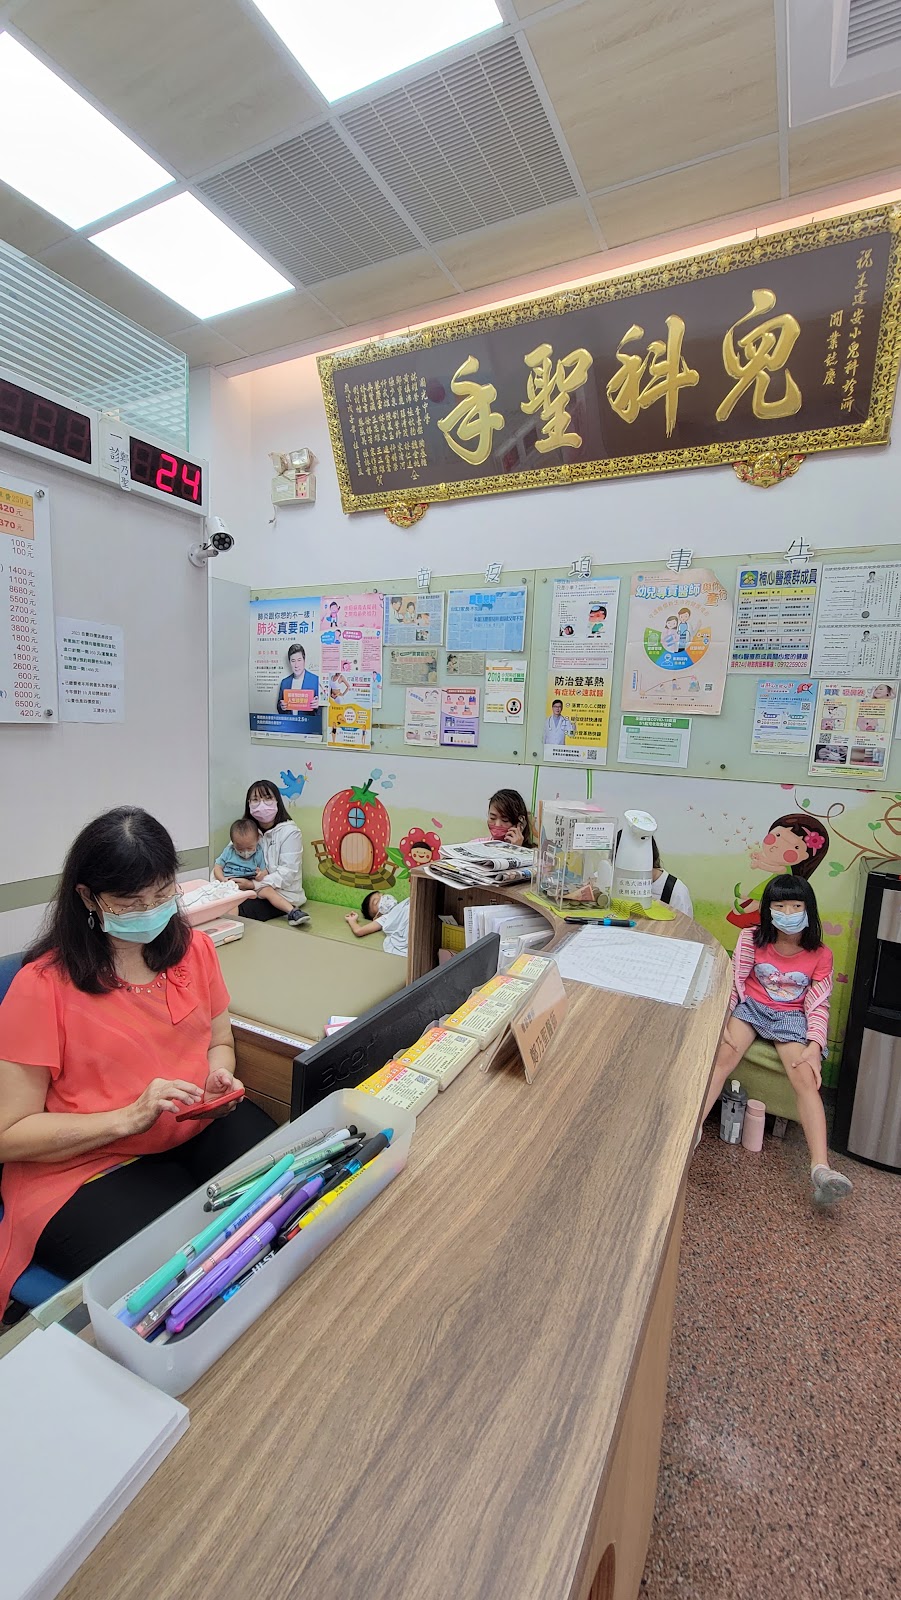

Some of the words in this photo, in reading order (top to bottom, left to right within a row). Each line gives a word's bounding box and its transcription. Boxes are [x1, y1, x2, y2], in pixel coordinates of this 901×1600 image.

[156, 452, 201, 501] 24
[554, 676, 604, 687] 防治登革熱
[554, 688, 576, 696] 有症狀
